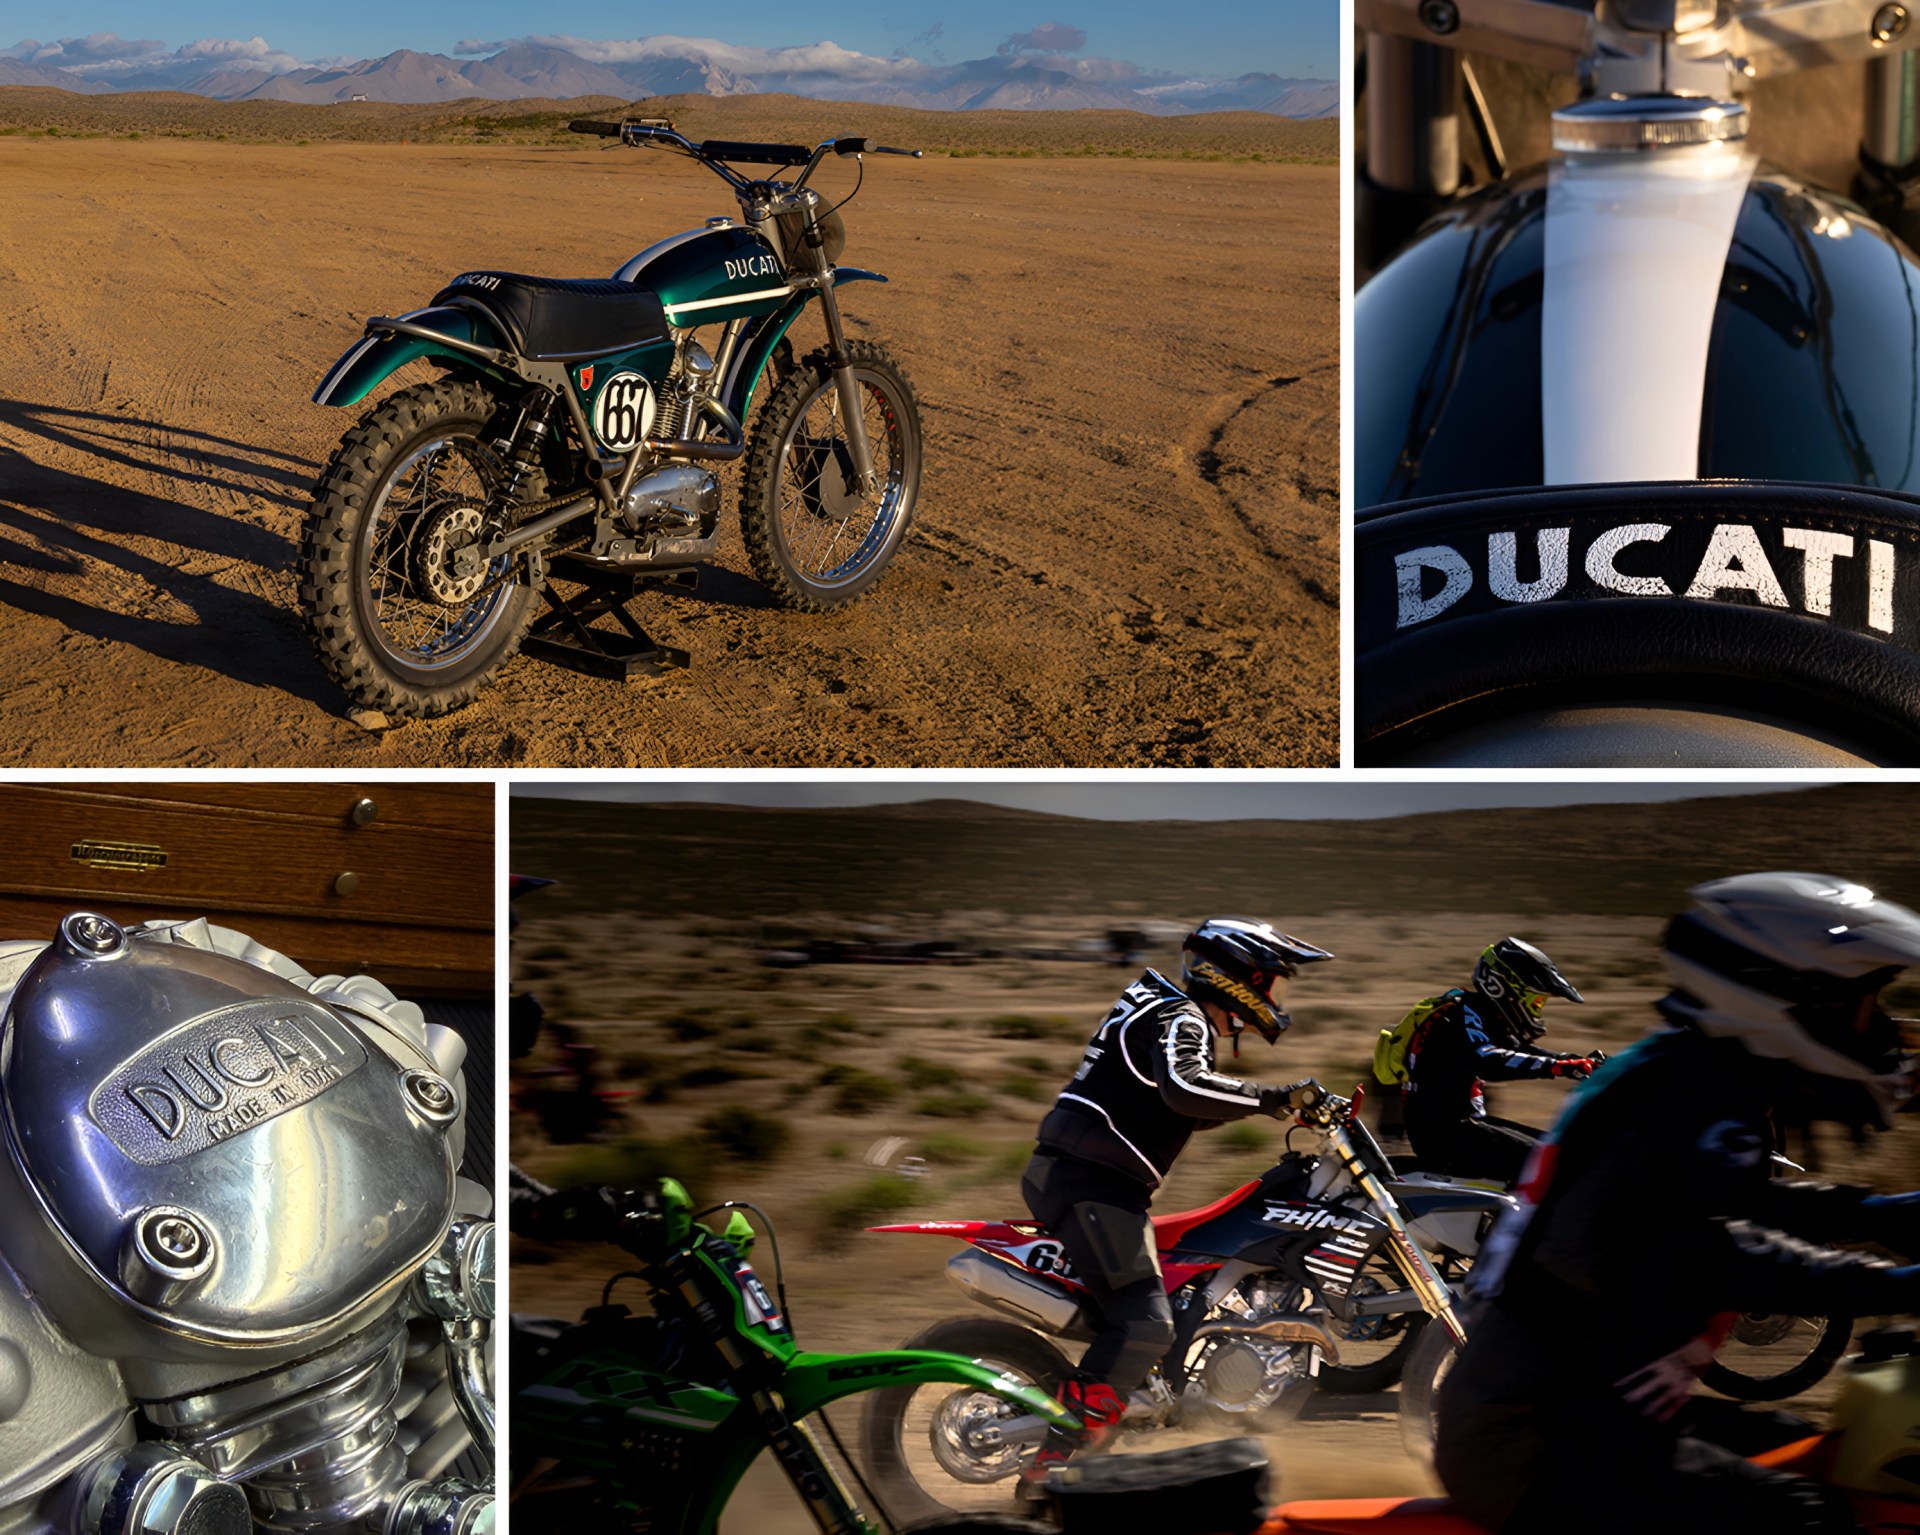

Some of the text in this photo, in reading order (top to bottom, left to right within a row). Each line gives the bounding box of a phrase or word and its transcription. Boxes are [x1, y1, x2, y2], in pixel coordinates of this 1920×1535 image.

[724, 254, 779, 280] DUCATI
[603, 379, 648, 446] 667
[1395, 523, 1895, 634] DUCATI
[124, 1014, 345, 1140] DUCATI
[208, 1098, 265, 1140] MADE
[271, 1083, 297, 1106] IN
